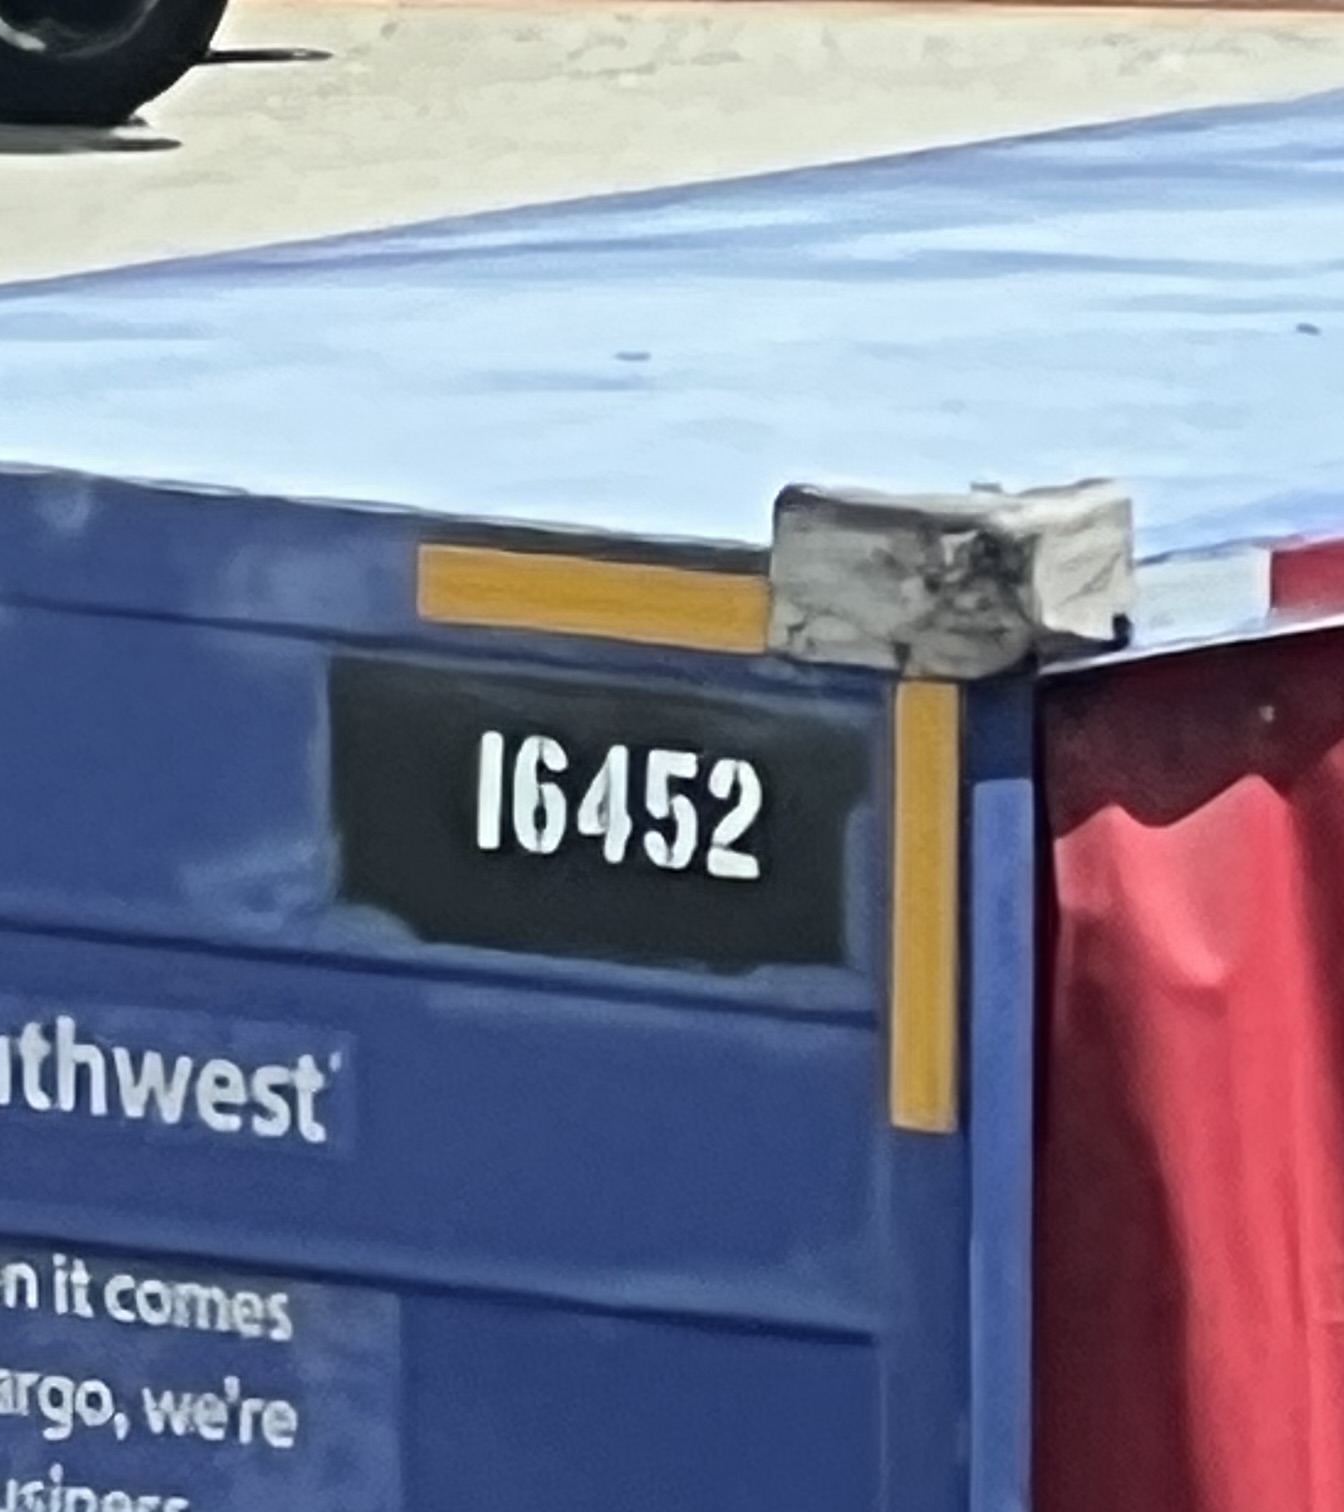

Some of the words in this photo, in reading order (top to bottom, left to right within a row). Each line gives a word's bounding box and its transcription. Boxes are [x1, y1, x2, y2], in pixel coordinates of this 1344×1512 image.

[476, 729, 763, 880] 16452
[52, 1253, 94, 1319] it
[104, 1272, 294, 1341] comes
[141, 1375, 298, 1448] we're
